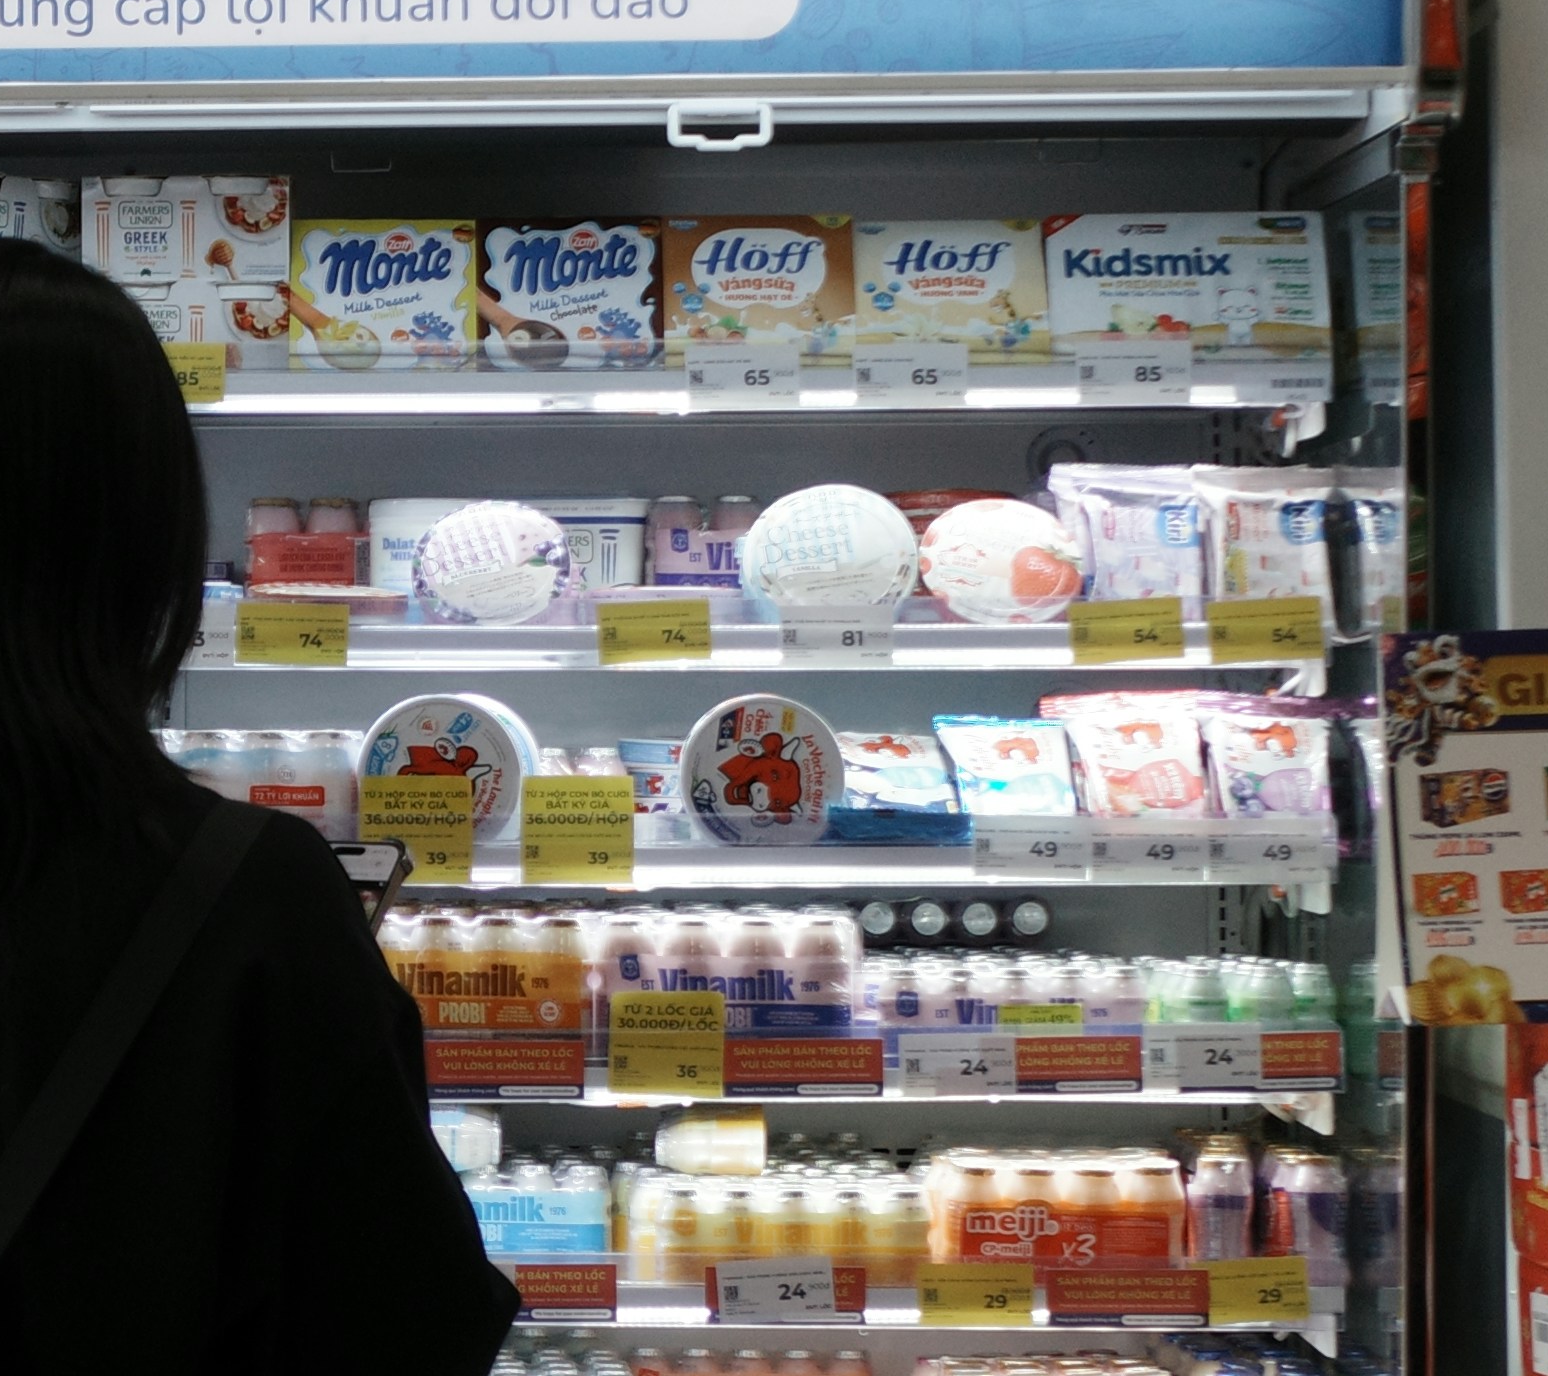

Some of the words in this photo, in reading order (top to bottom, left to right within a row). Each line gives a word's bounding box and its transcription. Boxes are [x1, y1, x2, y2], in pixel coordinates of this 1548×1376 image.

[320, 234, 454, 295] Monte
[505, 230, 639, 296] Monte
[695, 236, 822, 275] Höff
[884, 238, 1012, 275] Höff
[1064, 247, 1231, 277] Kidsmix
[1135, 366, 1162, 382] 85
[1030, 842, 1056, 857] 49
[623, 1004, 642, 1017] TỪ
[645, 1006, 653, 1017] 2
[656, 1004, 681, 1017] LỐC
[685, 1004, 714, 1017] GIÁ
[967, 1209, 1058, 1240] meiji
